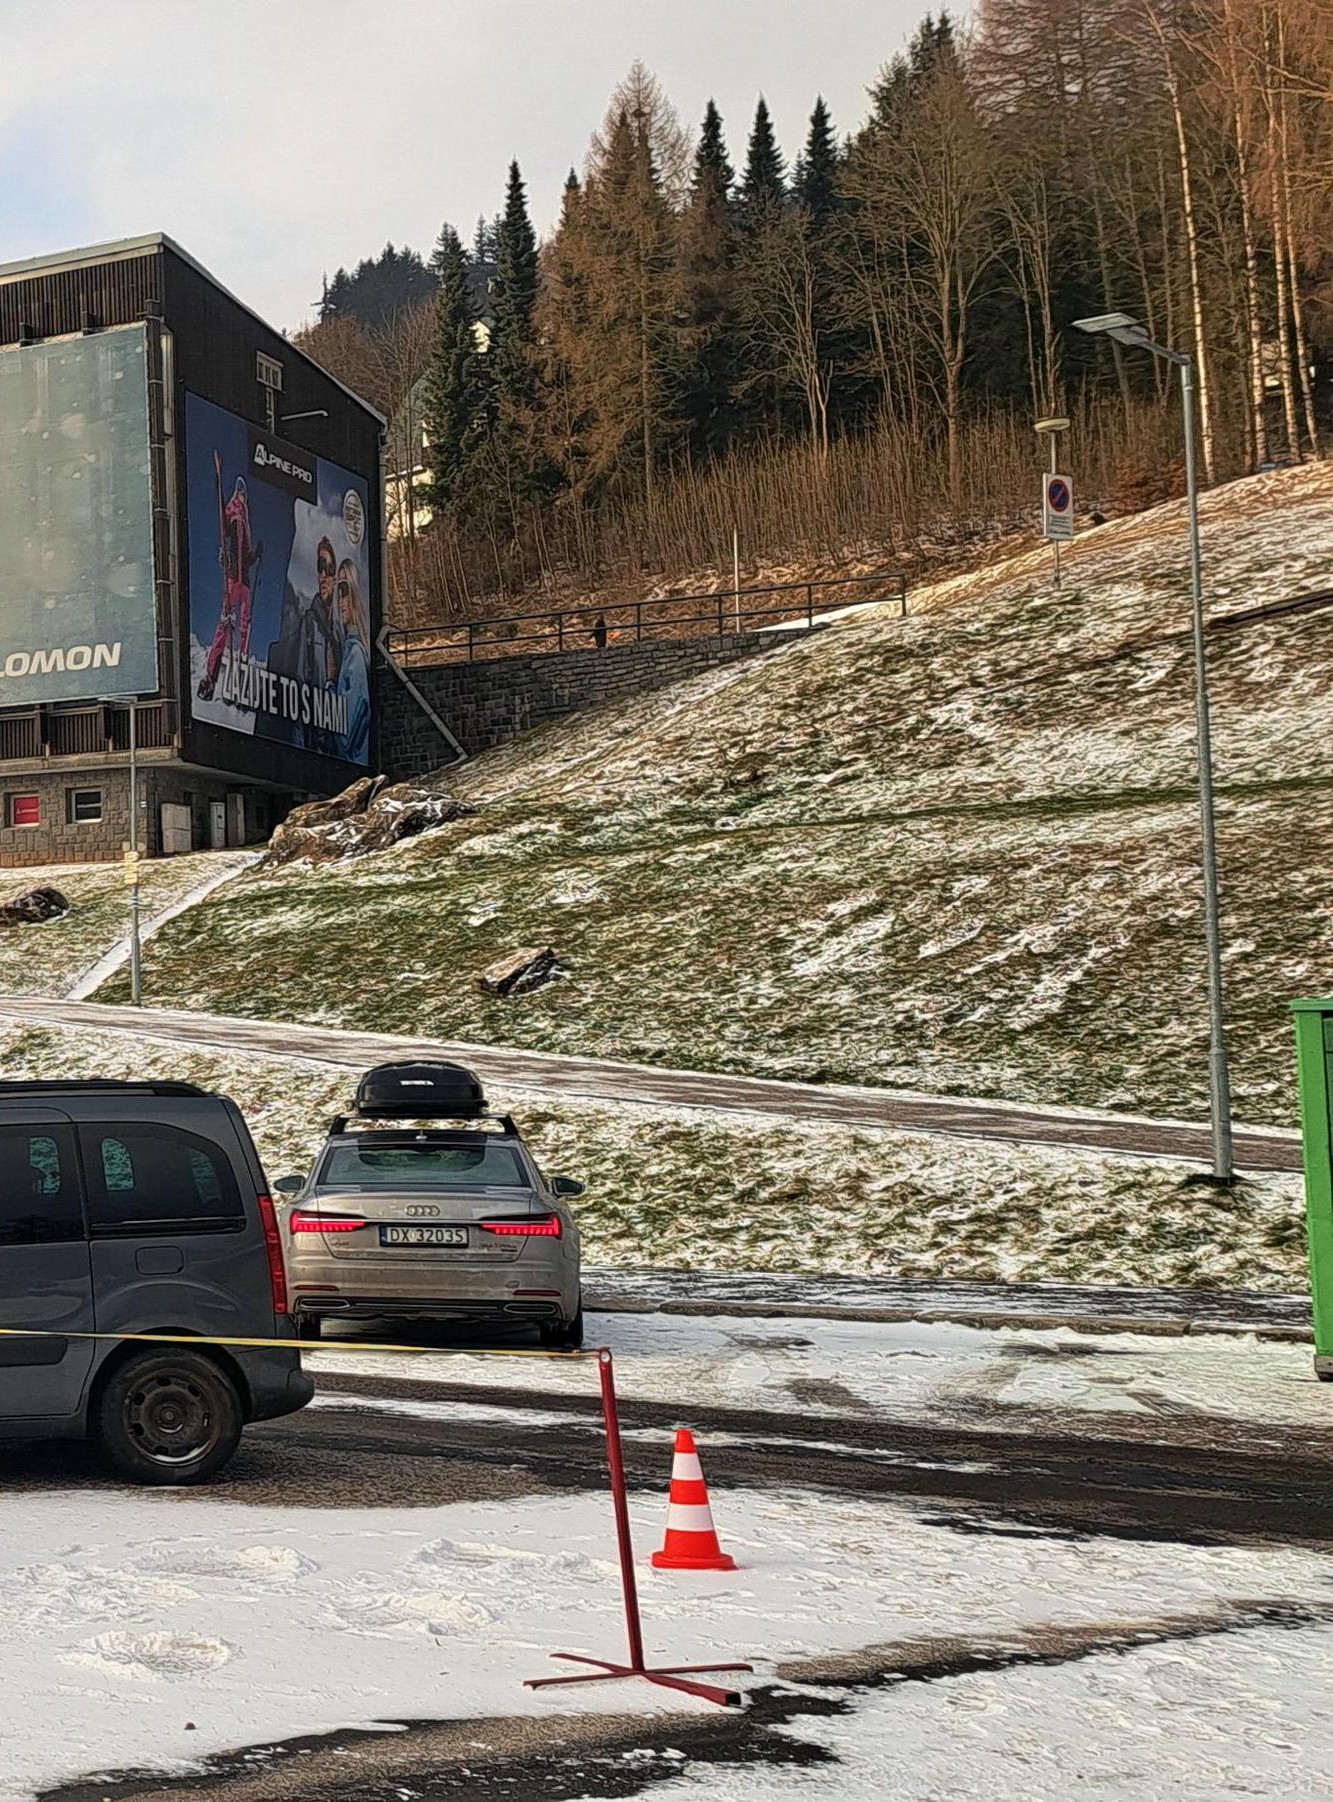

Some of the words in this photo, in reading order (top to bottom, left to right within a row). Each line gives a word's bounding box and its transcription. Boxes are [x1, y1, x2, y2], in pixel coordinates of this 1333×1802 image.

[254, 443, 292, 475] ALPINE
[293, 464, 313, 484] PRO
[280, 675, 299, 721] TO
[301, 683, 311, 724] S
[313, 681, 348, 735] NÁMI
[390, 1228, 409, 1242] DX
[417, 1228, 464, 1243] 32035
